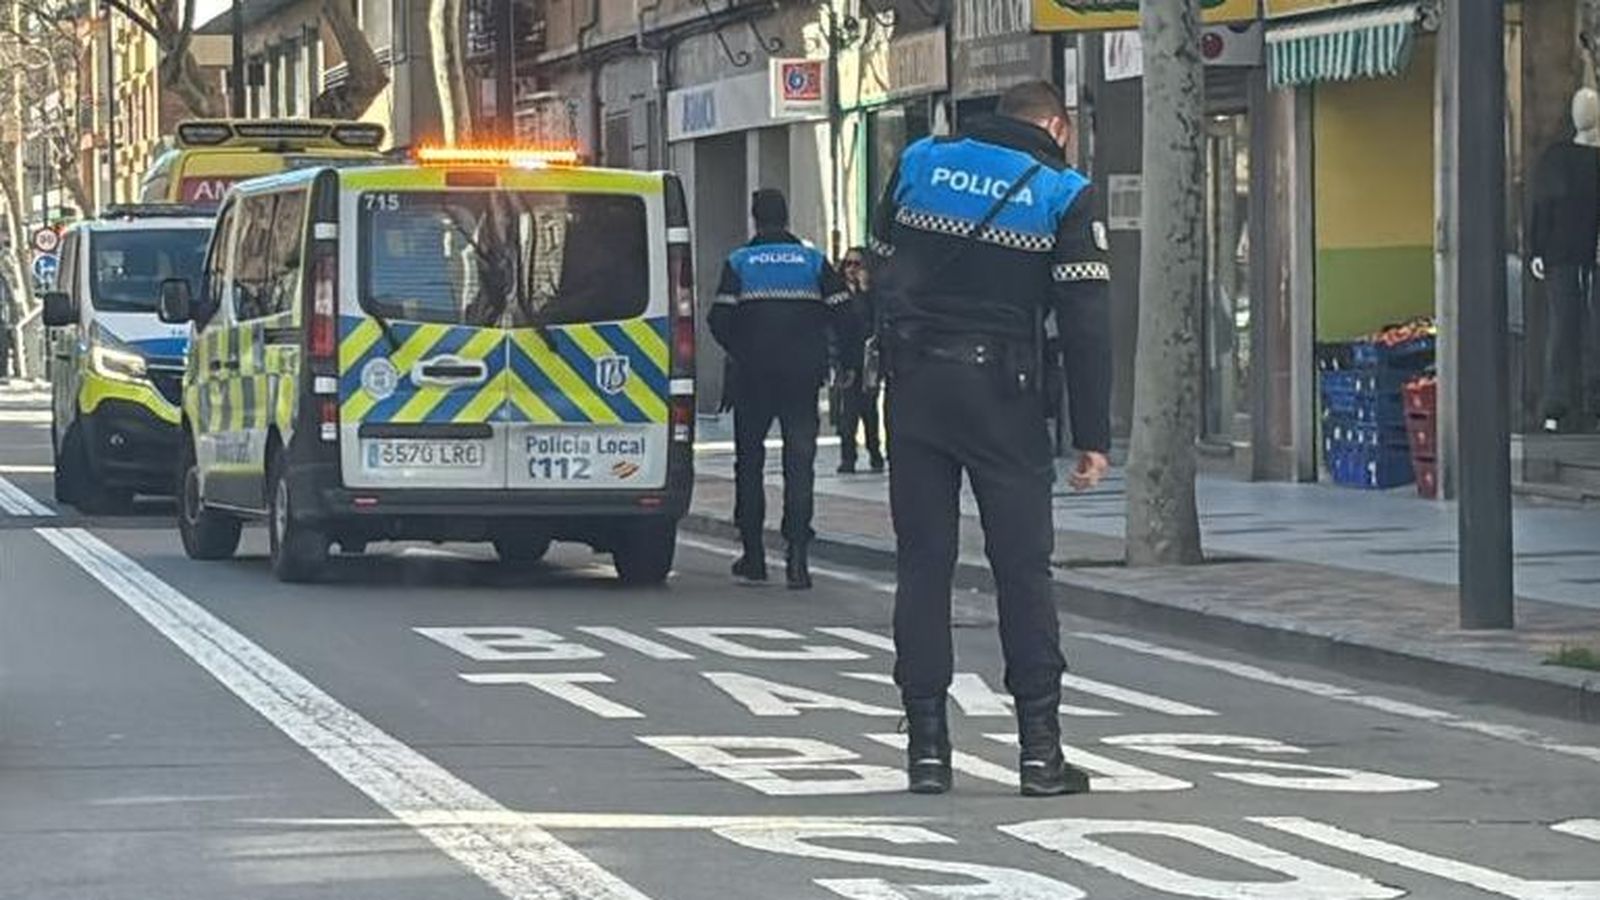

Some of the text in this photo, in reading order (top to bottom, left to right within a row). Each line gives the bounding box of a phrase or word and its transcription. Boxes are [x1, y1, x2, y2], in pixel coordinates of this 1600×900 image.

[365, 194, 399, 210] 715
[931, 167, 1033, 206] POLICA
[598, 436, 645, 454] Local
[635, 734, 1441, 797] BUS
[711, 812, 1600, 900] SOL
